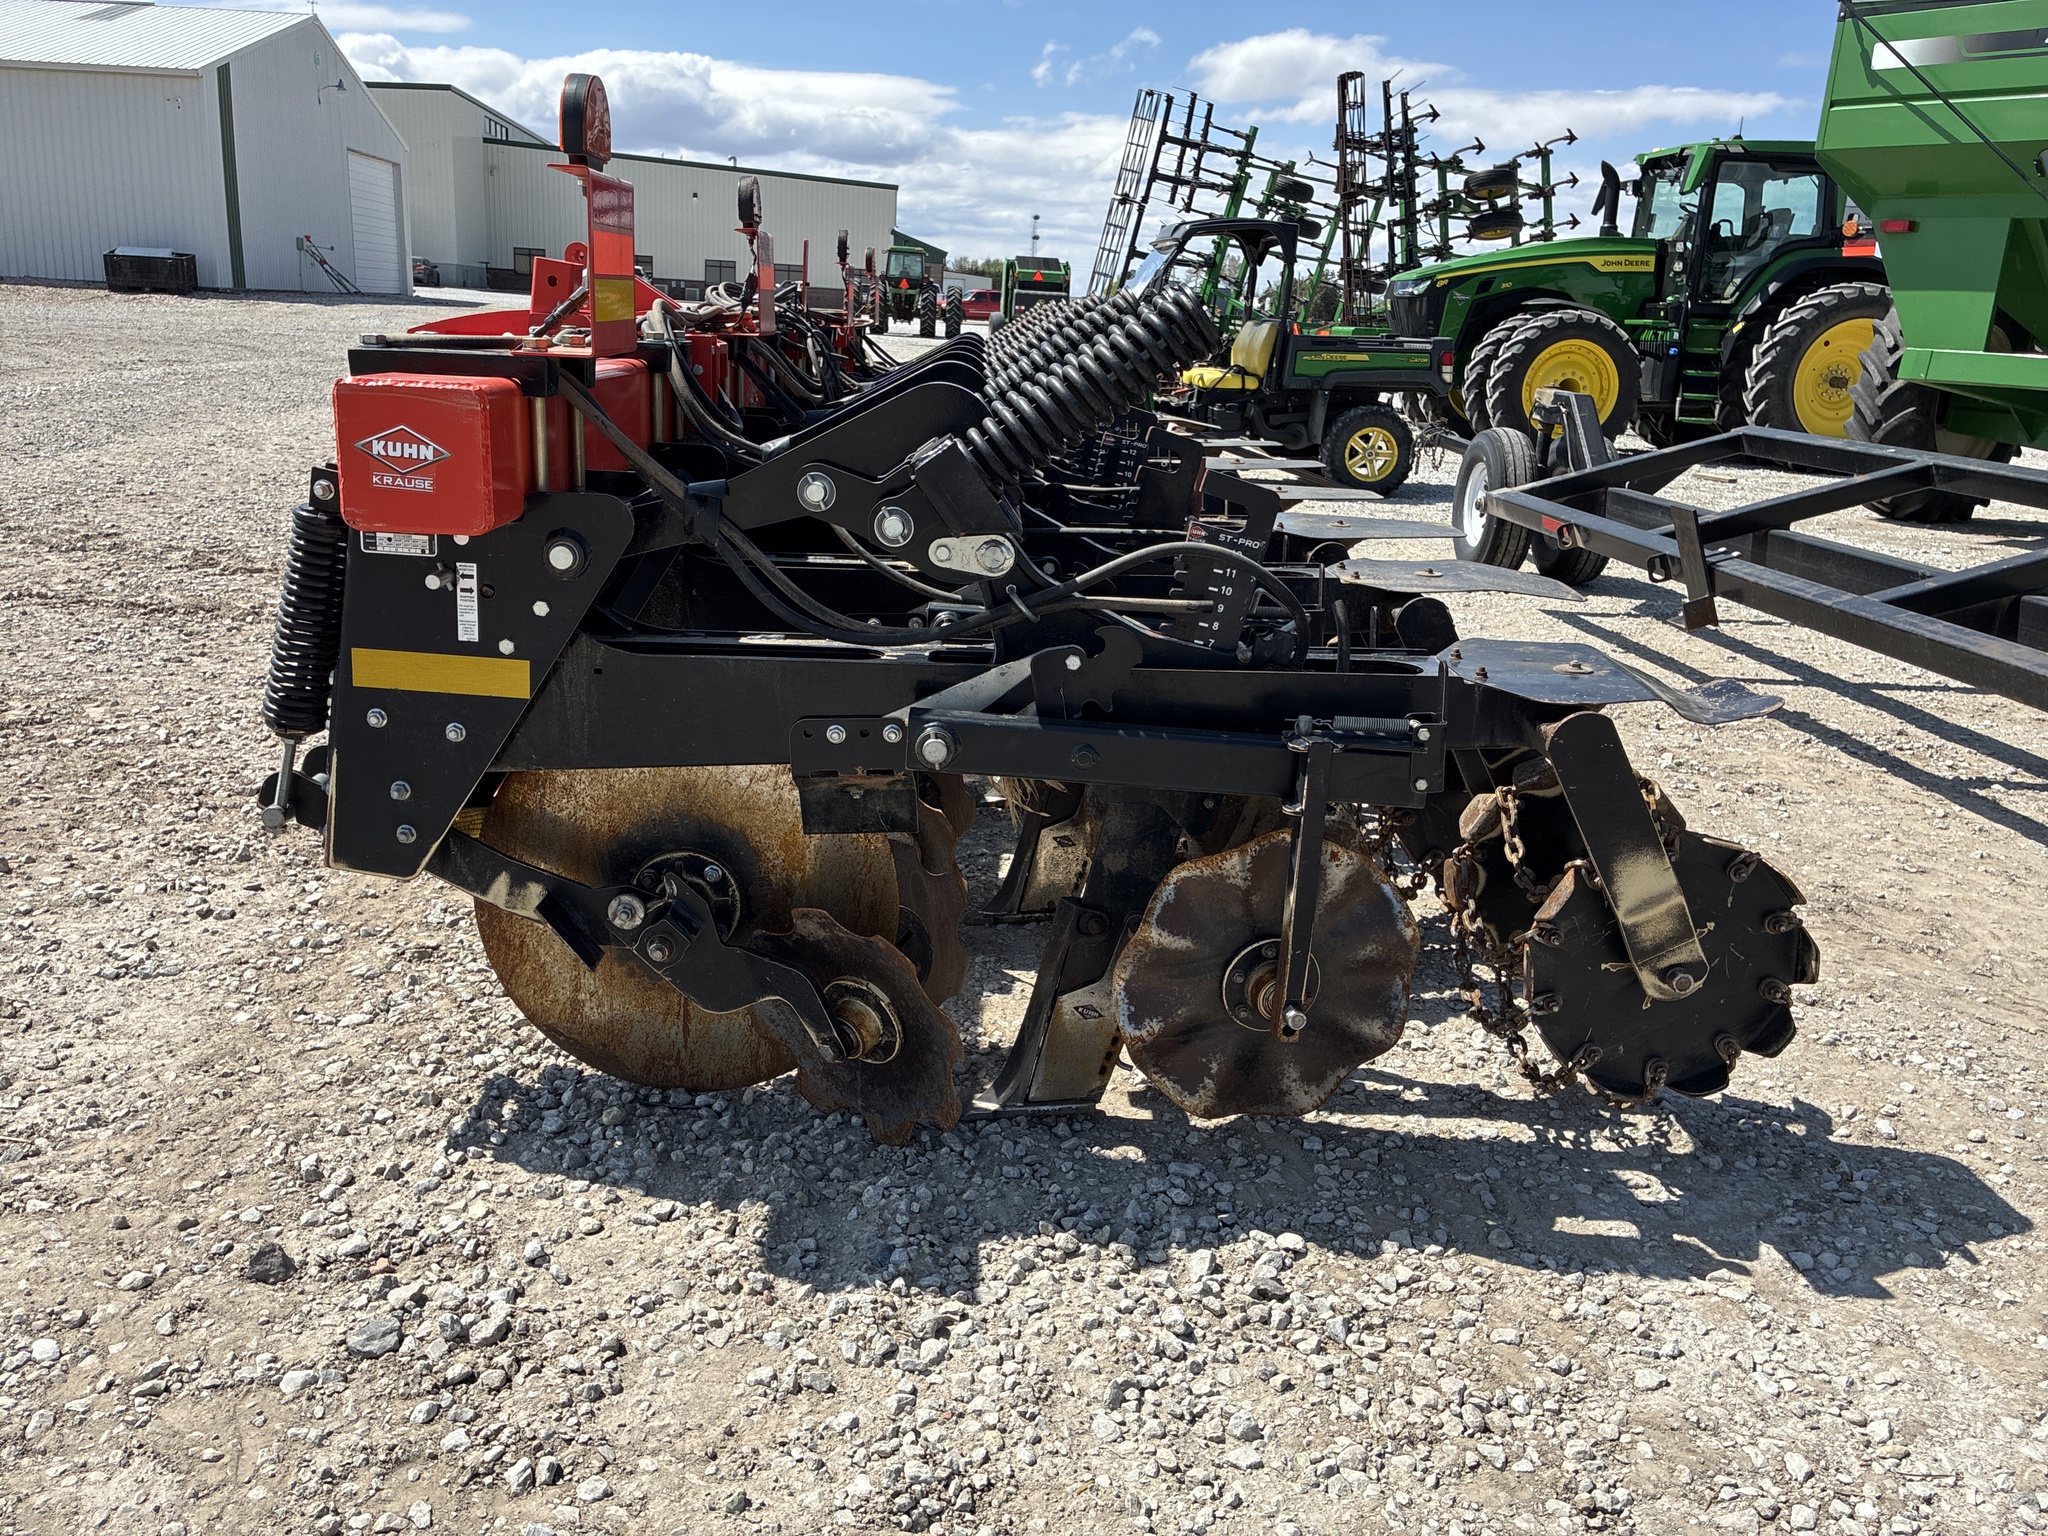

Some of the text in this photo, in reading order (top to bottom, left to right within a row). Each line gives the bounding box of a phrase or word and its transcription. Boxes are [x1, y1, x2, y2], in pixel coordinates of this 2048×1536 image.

[1601, 259, 1650, 267] JOHN DEERE
[1435, 279, 1449, 288] 8R
[372, 439, 434, 460] KUHN
[372, 475, 433, 490] KRAUSE
[1218, 533, 1260, 549] ST-PRO
[1225, 568, 1237, 579] 11
[1220, 585, 1233, 596] 10
[1217, 603, 1224, 613] 9
[1212, 621, 1219, 631] 8
[1208, 638, 1215, 648] 7
[1077, 1007, 1099, 1017] KUHN
